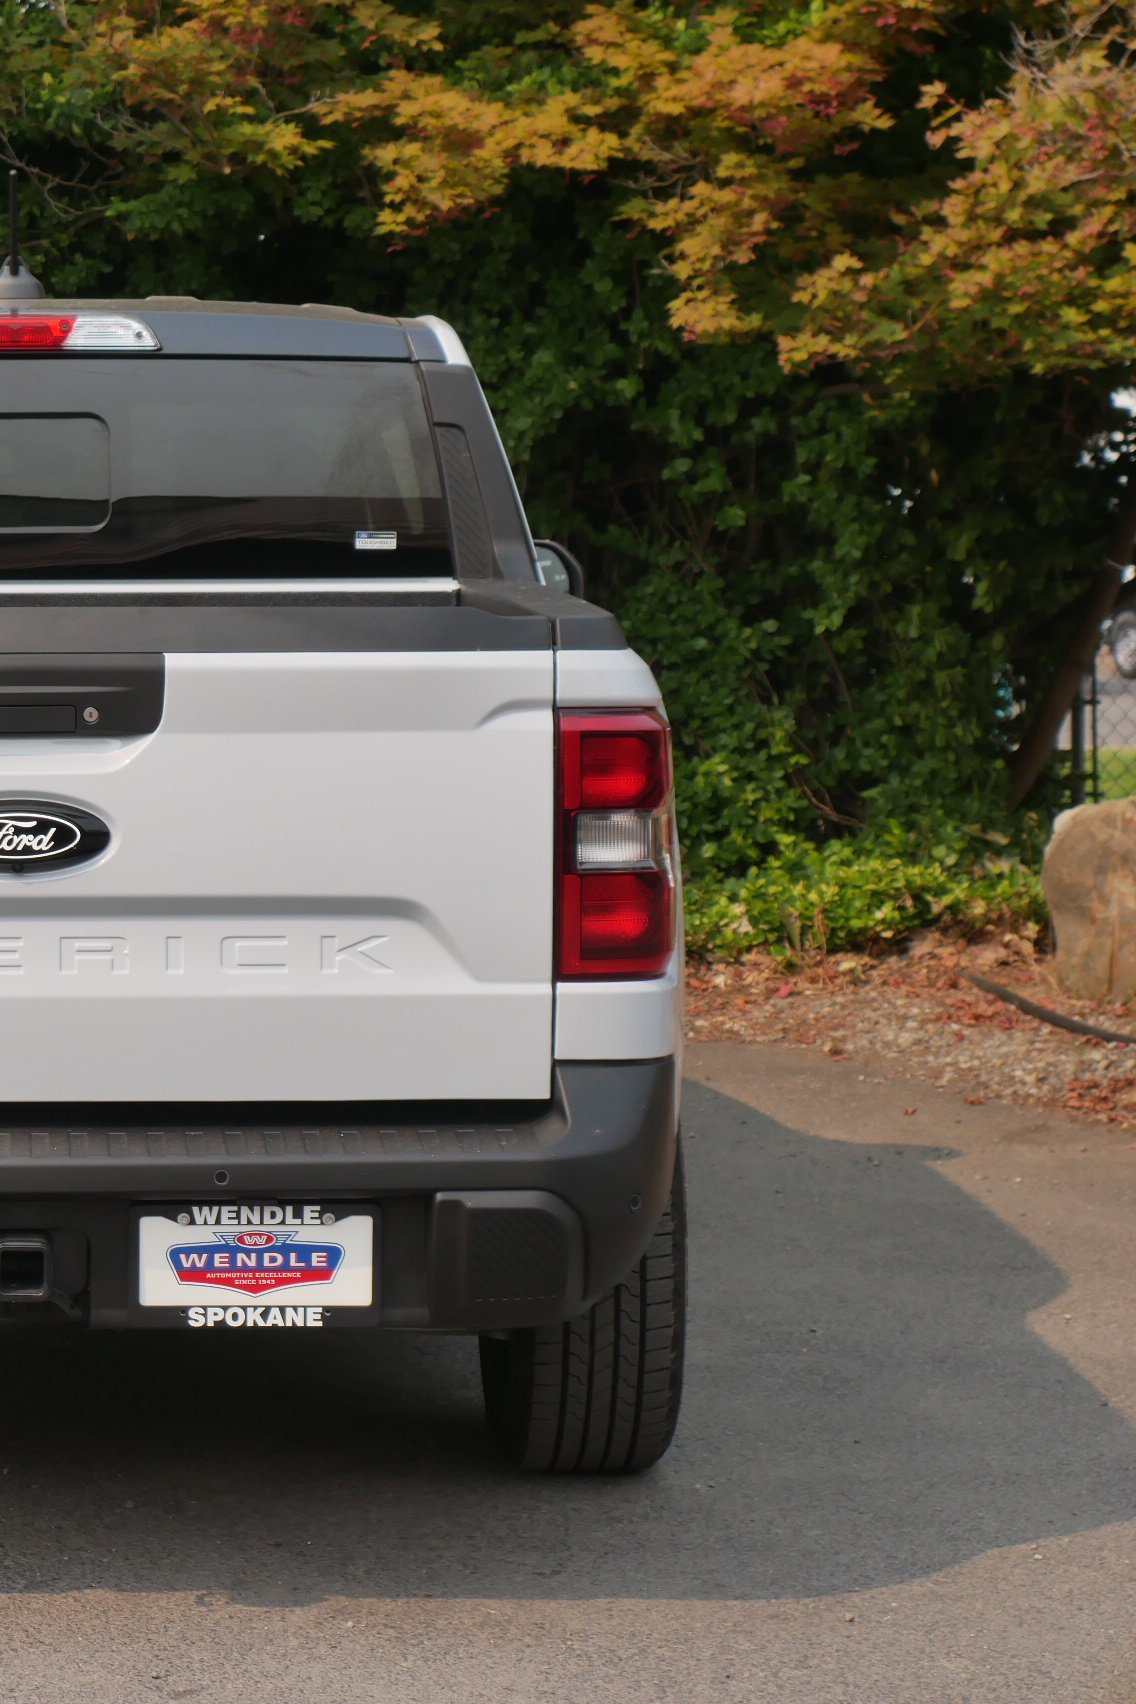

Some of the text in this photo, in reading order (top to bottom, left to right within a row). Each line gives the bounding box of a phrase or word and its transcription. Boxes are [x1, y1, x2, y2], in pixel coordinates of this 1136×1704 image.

[191, 1205, 322, 1225] WENDLE
[179, 1252, 329, 1268] WENDLE
[188, 1306, 323, 1327] SPOKANE
